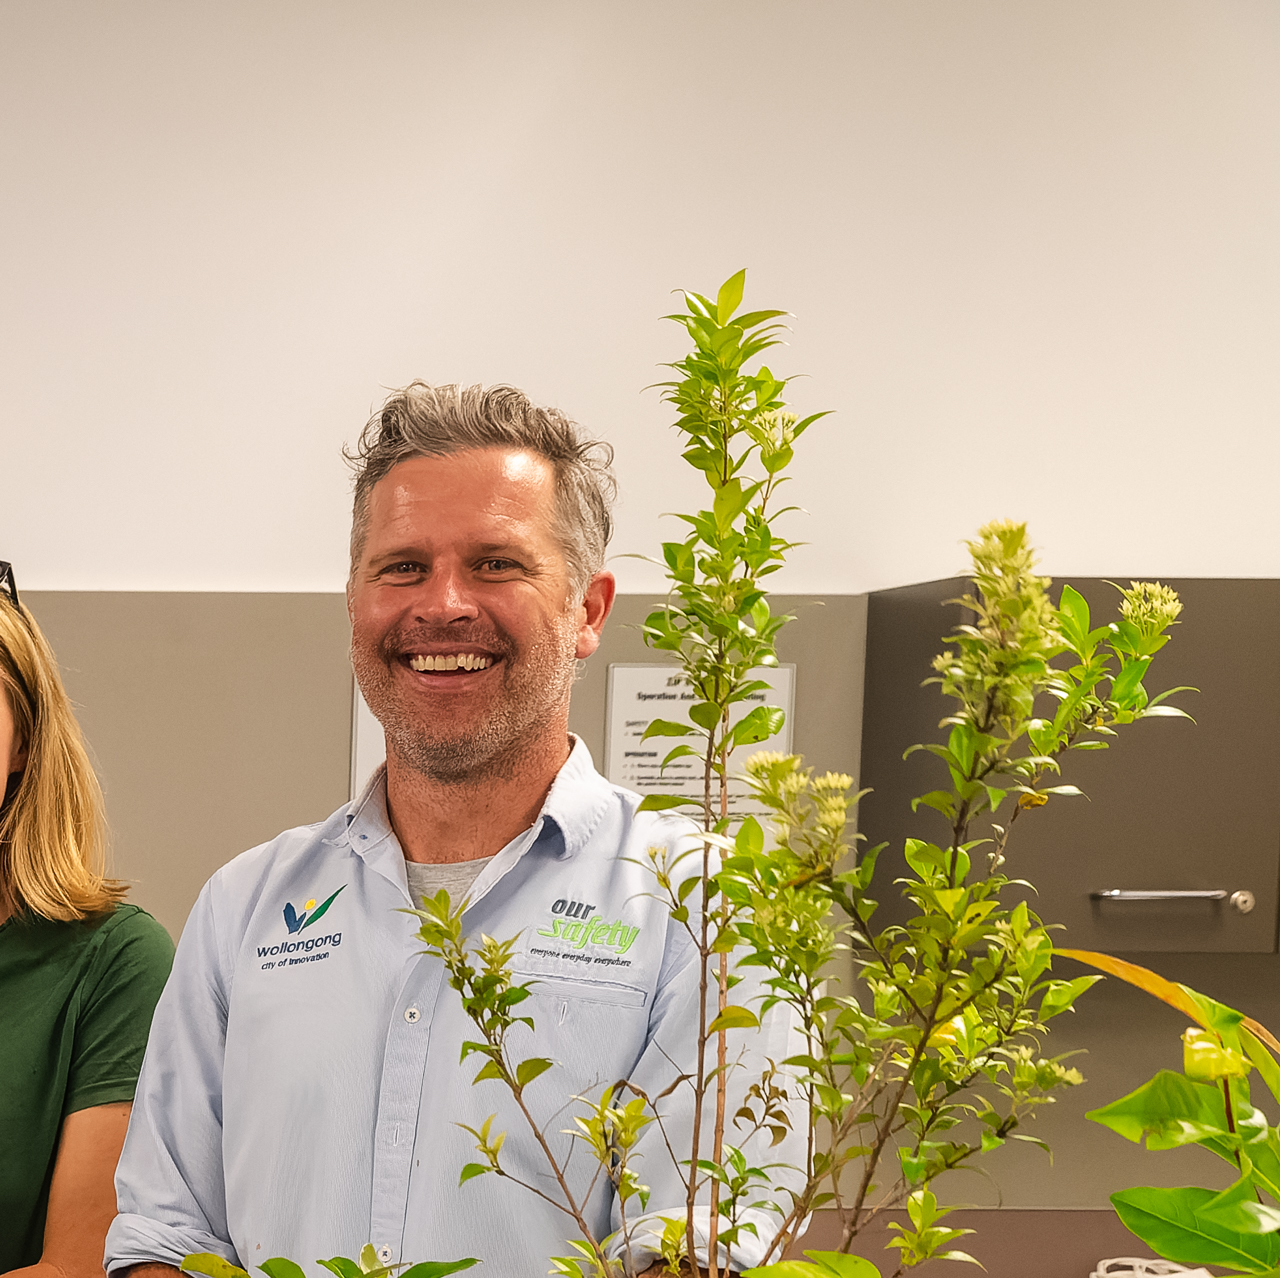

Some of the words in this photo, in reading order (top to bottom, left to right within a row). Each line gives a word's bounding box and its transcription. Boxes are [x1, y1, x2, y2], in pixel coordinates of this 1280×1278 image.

[551, 898, 596, 920] our
[256, 930, 343, 959] wollongong
[537, 915, 641, 954] safety
[261, 959, 278, 972] city
[278, 957, 288, 968] of
